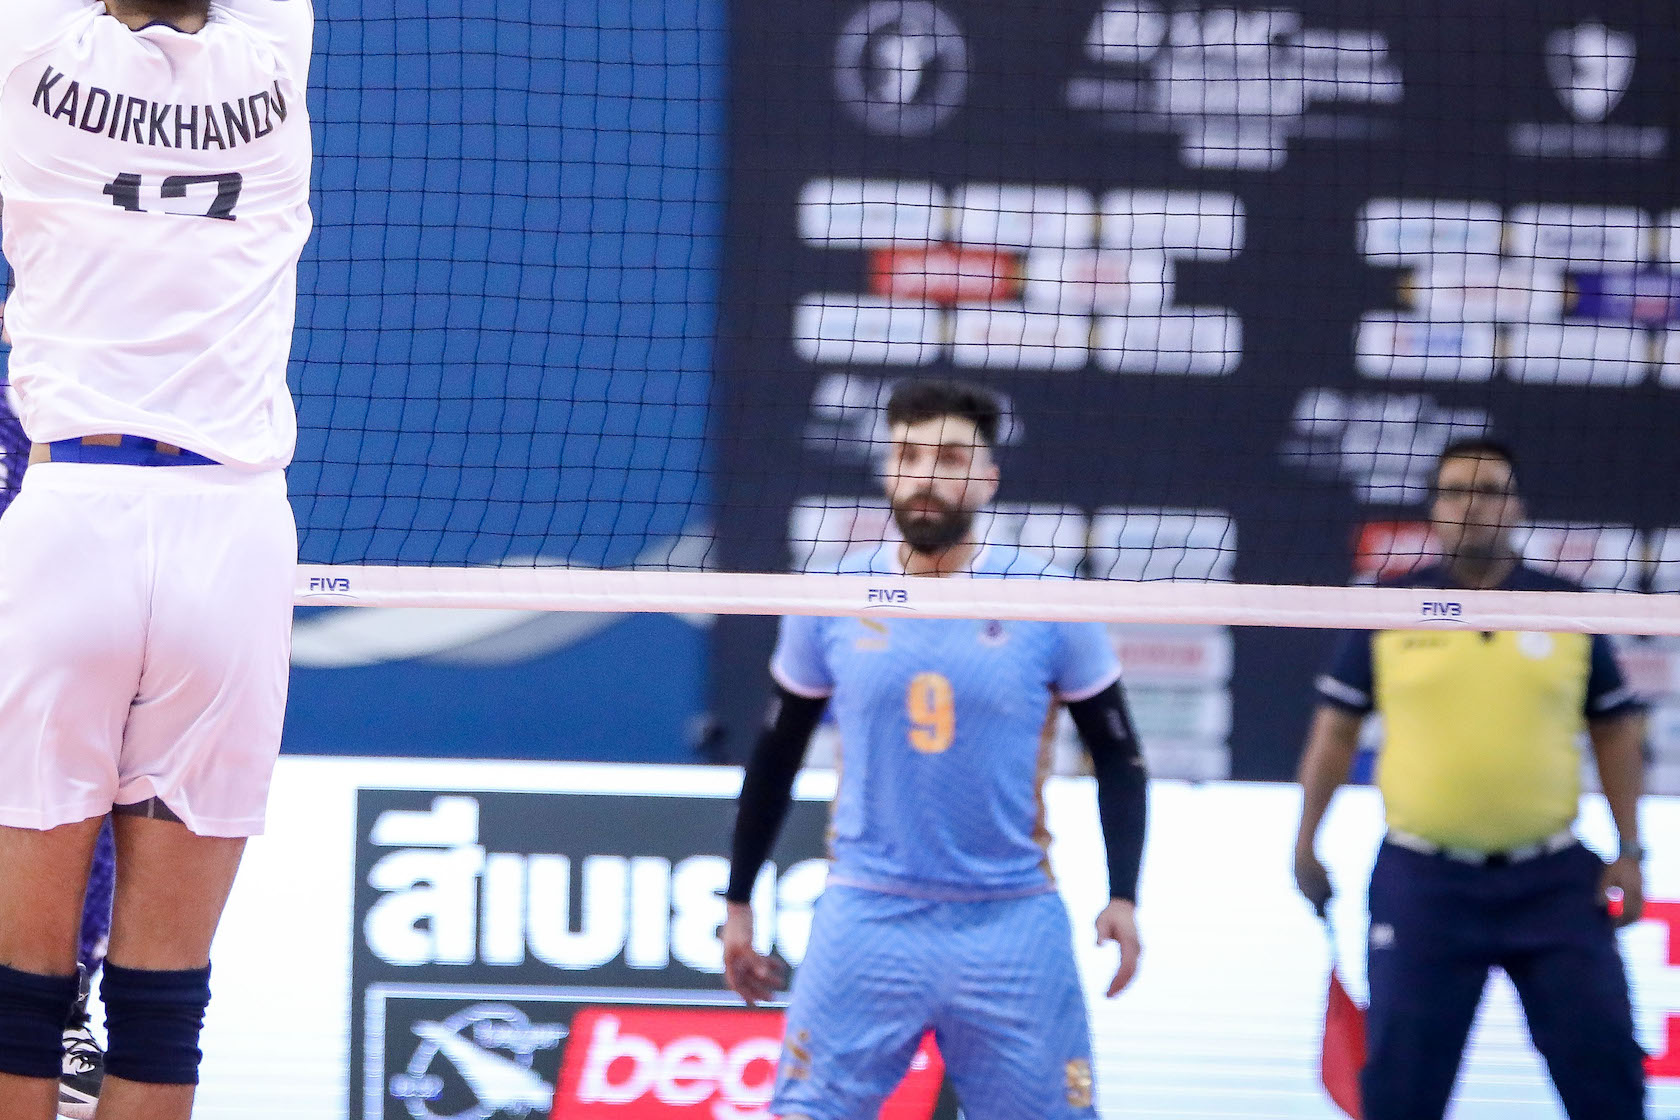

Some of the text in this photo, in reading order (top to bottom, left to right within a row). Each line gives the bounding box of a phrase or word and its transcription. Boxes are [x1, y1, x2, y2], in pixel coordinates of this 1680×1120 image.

[31, 64, 288, 151] KADIRKHANOV
[309, 577, 351, 592] FIVB
[868, 588, 908, 603] FIVB
[1422, 602, 1462, 616] FIVB
[906, 672, 955, 754] 9
